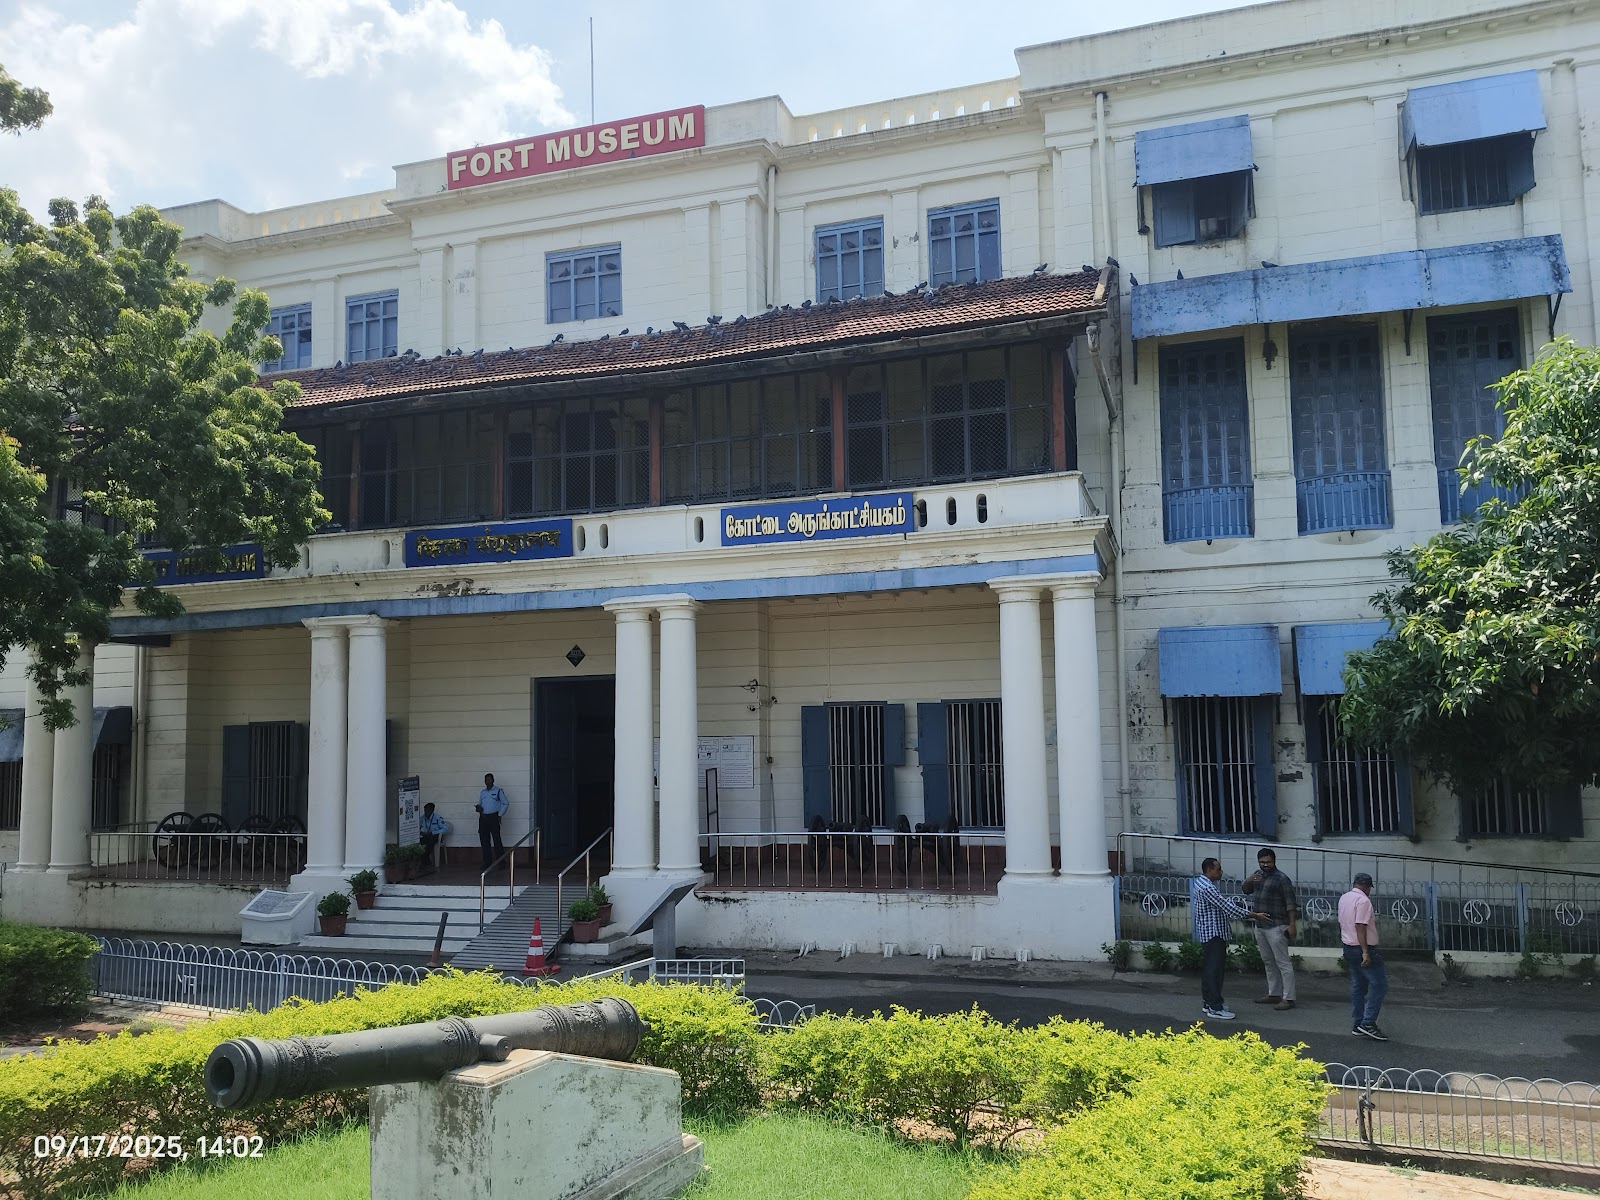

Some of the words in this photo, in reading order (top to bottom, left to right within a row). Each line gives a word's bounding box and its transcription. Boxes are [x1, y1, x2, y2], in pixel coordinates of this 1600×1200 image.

[451, 143, 534, 182] FORT
[545, 112, 695, 164] MUSEUM
[725, 514, 785, 538] கோட்டை
[787, 497, 906, 537] அருங்காட்சியகம்
